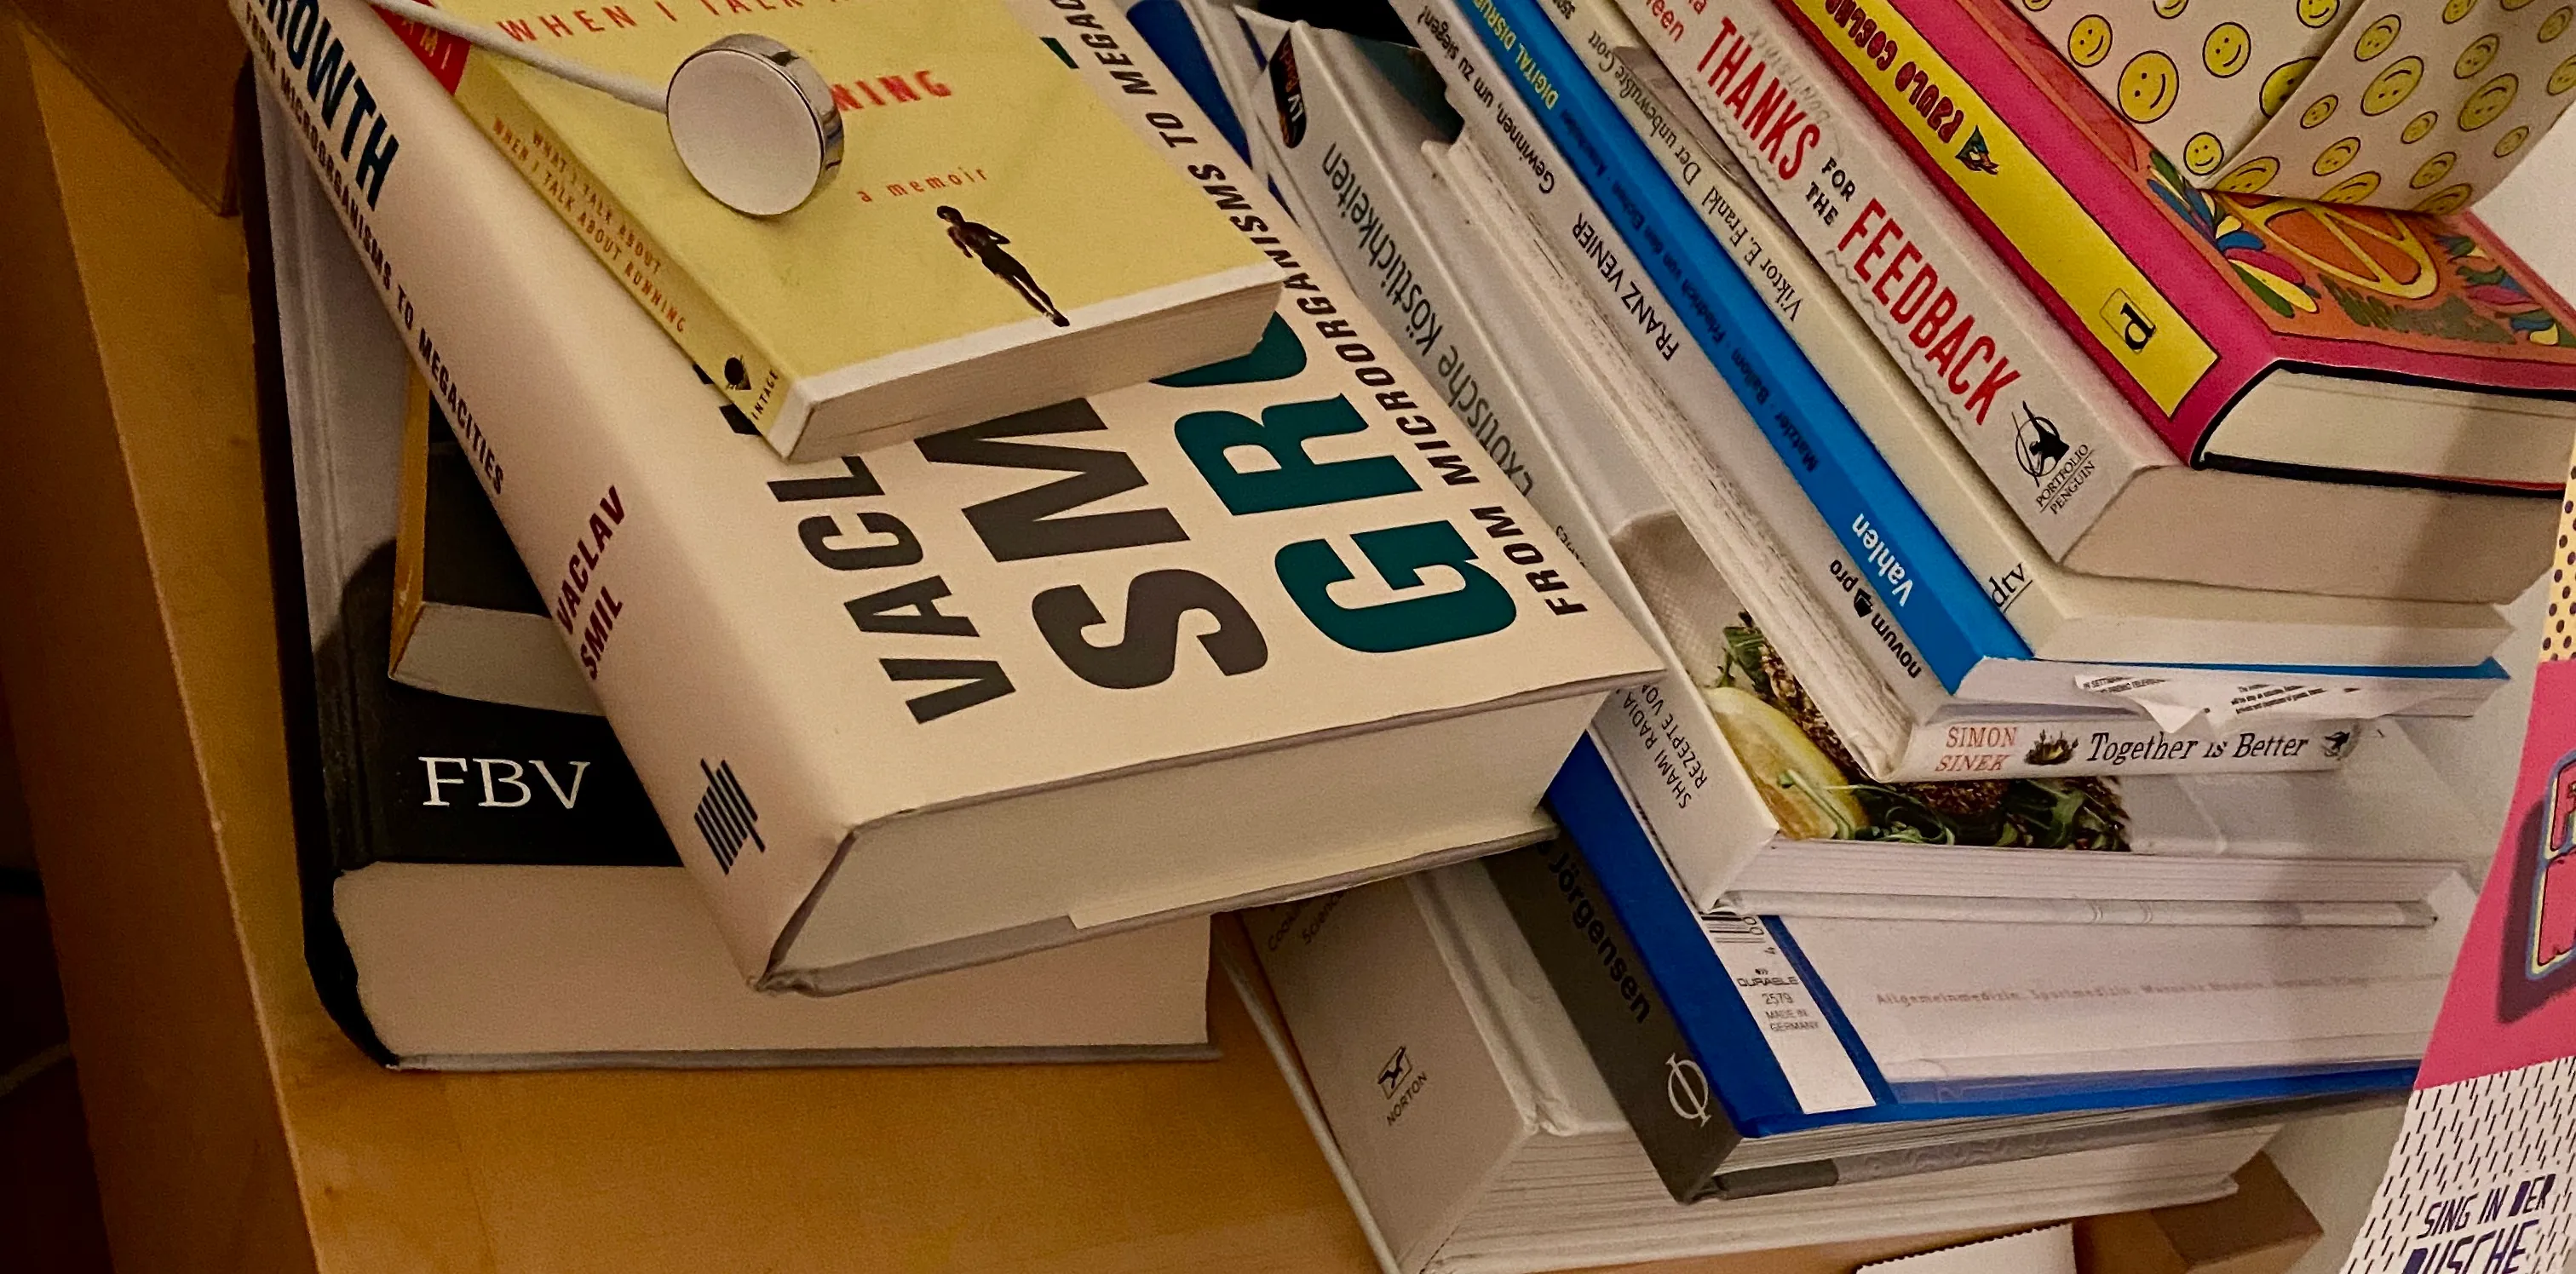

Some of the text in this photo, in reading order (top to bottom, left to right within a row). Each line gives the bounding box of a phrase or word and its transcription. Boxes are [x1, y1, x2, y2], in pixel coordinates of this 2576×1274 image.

[497, 1, 636, 43] WHEN
[664, 0, 678, 22] I
[1417, 6, 1556, 195] Gewinnen, um zu siegen!
[1516, 42, 1560, 110] DIGITAL
[1588, 29, 1702, 187] Der unbewußte Gott
[1695, 17, 1820, 181] THANKS
[1895, 60, 1965, 144] PAULO
[1145, 112, 1198, 149] TO
[492, 115, 530, 163] WHEN
[542, 170, 578, 214] TALK
[577, 210, 624, 261] ABOUT
[623, 260, 687, 334] RUNNING
[532, 129, 568, 175] WHAT
[582, 181, 614, 226] TALK
[618, 223, 662, 276] ABOUT
[857, 165, 990, 204] a memoir
[1804, 181, 1839, 227] THE
[1820, 156, 1857, 204] FOR
[280, 67, 393, 290] MICROORGANISMS
[397, 284, 414, 331] TO
[418, 326, 505, 496] MEGACITIES
[1323, 141, 1443, 353] Köstlichkeiten
[1572, 212, 1680, 361] FRANZ VENIER
[1701, 185, 1803, 323] Viktor E. Frankl
[1187, 162, 1481, 487] MICROORGANISMS
[1837, 197, 2021, 427] FEEDBACK
[2123, 301, 2157, 353] d
[2035, 443, 2090, 508] PORTFOLIO
[2049, 461, 2096, 515] PENGUIN
[555, 485, 626, 635] VACLAV
[912, 396, 1269, 690] SM
[1469, 505, 1590, 617] FROM
[1850, 513, 1915, 608] Vahlen
[1992, 560, 2027, 610] dtv
[579, 585, 624, 680] SMIL
[768, 455, 1016, 725] VACL
[1829, 557, 1923, 680] novum pro
[1623, 689, 1693, 810] SHAMI RADIA
[1662, 712, 1708, 787] REZEPTE
[1934, 754, 2009, 772] SINEK
[1946, 726, 2018, 749] SIMON
[2085, 732, 2198, 765] Together
[2230, 732, 2310, 760] Better
[417, 755, 591, 810] FBV
[1548, 852, 1653, 1022] Jörgensen
[1761, 990, 1796, 1007] 2579
[1769, 1020, 1820, 1033] GERMANY
[1386, 1070, 1428, 1127] NORTON
[2416, 1193, 2478, 1240] SING
[2477, 1186, 2510, 1225] IN
